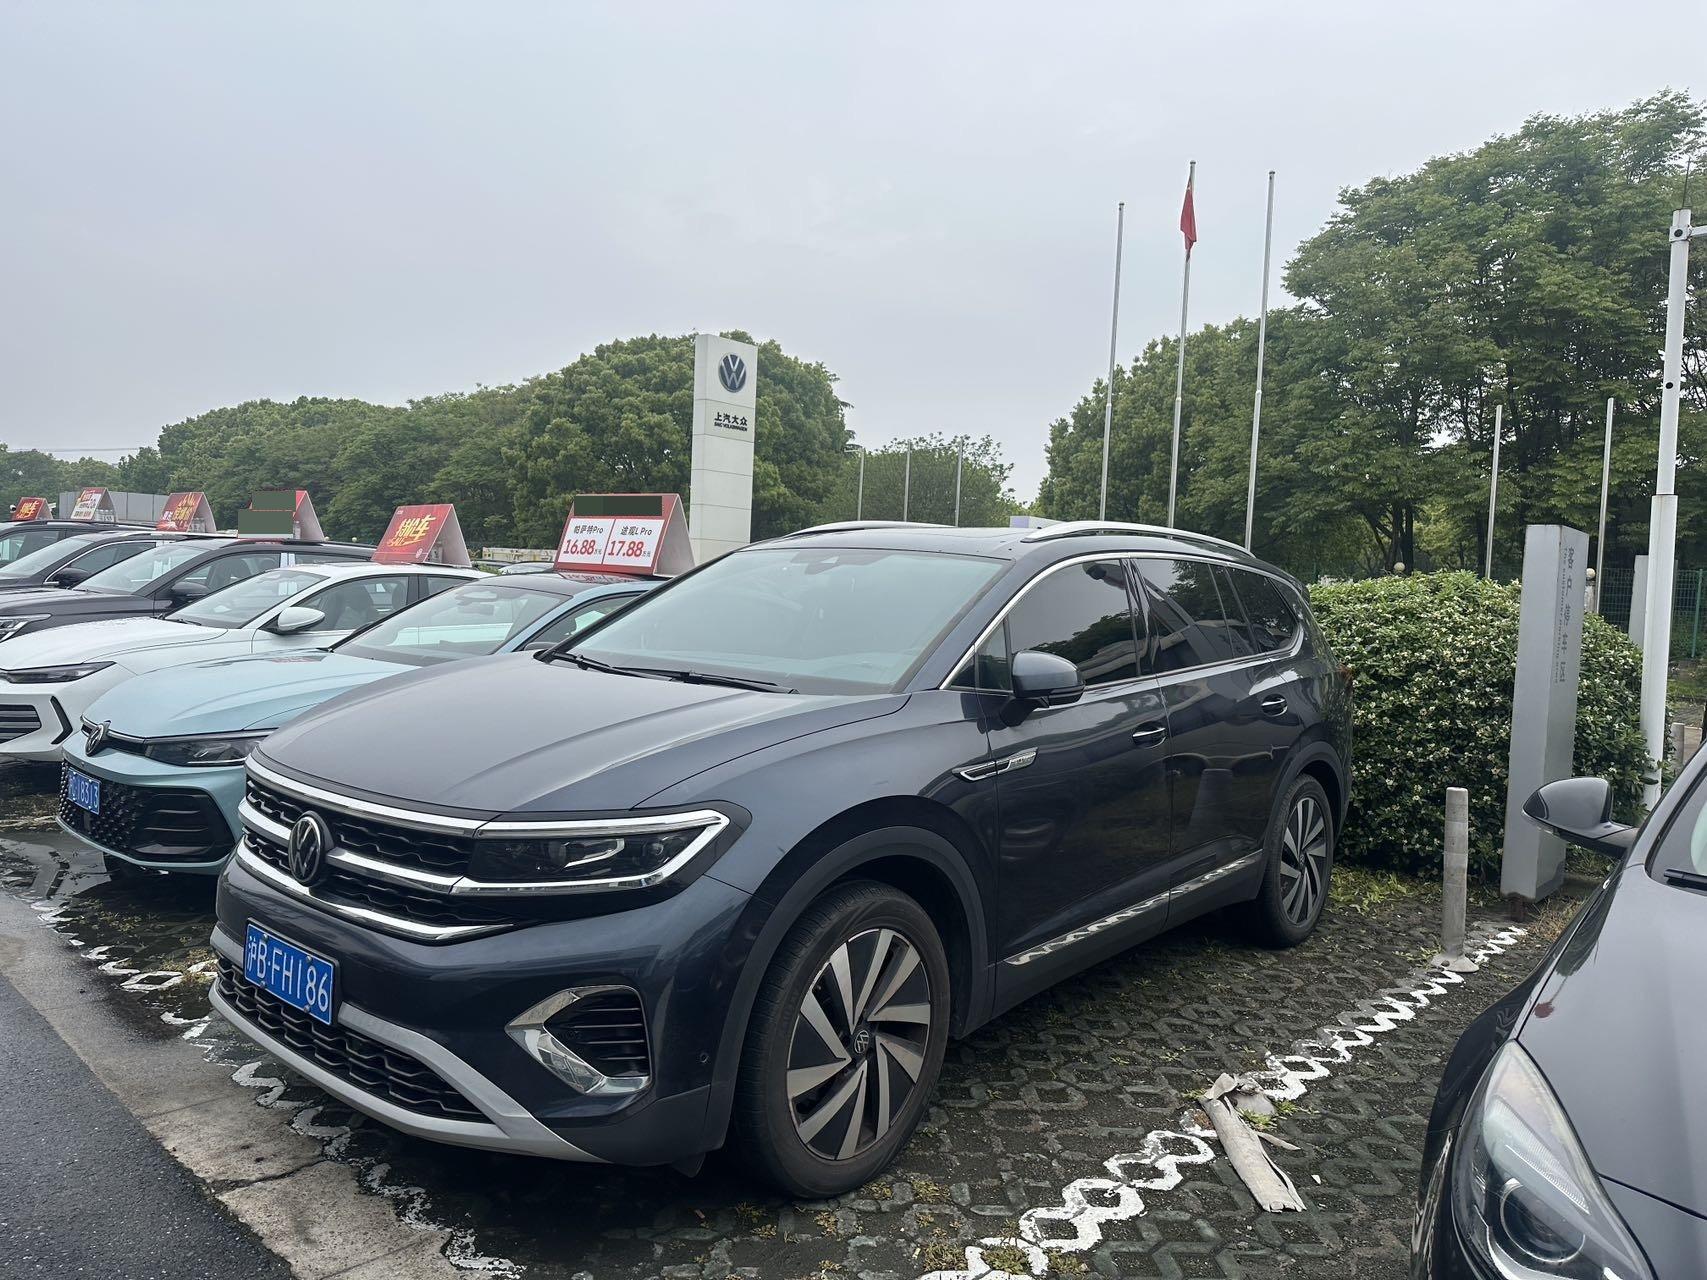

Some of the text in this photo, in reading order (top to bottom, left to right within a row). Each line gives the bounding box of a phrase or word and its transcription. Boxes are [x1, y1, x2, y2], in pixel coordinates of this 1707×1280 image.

[714, 411, 748, 426] 上汽大众
[573, 525, 604, 534] 帕萨特Pro
[620, 526, 653, 536] 途观L Pro
[563, 539, 596, 555] 16.88
[608, 540, 644, 557] 17.88
